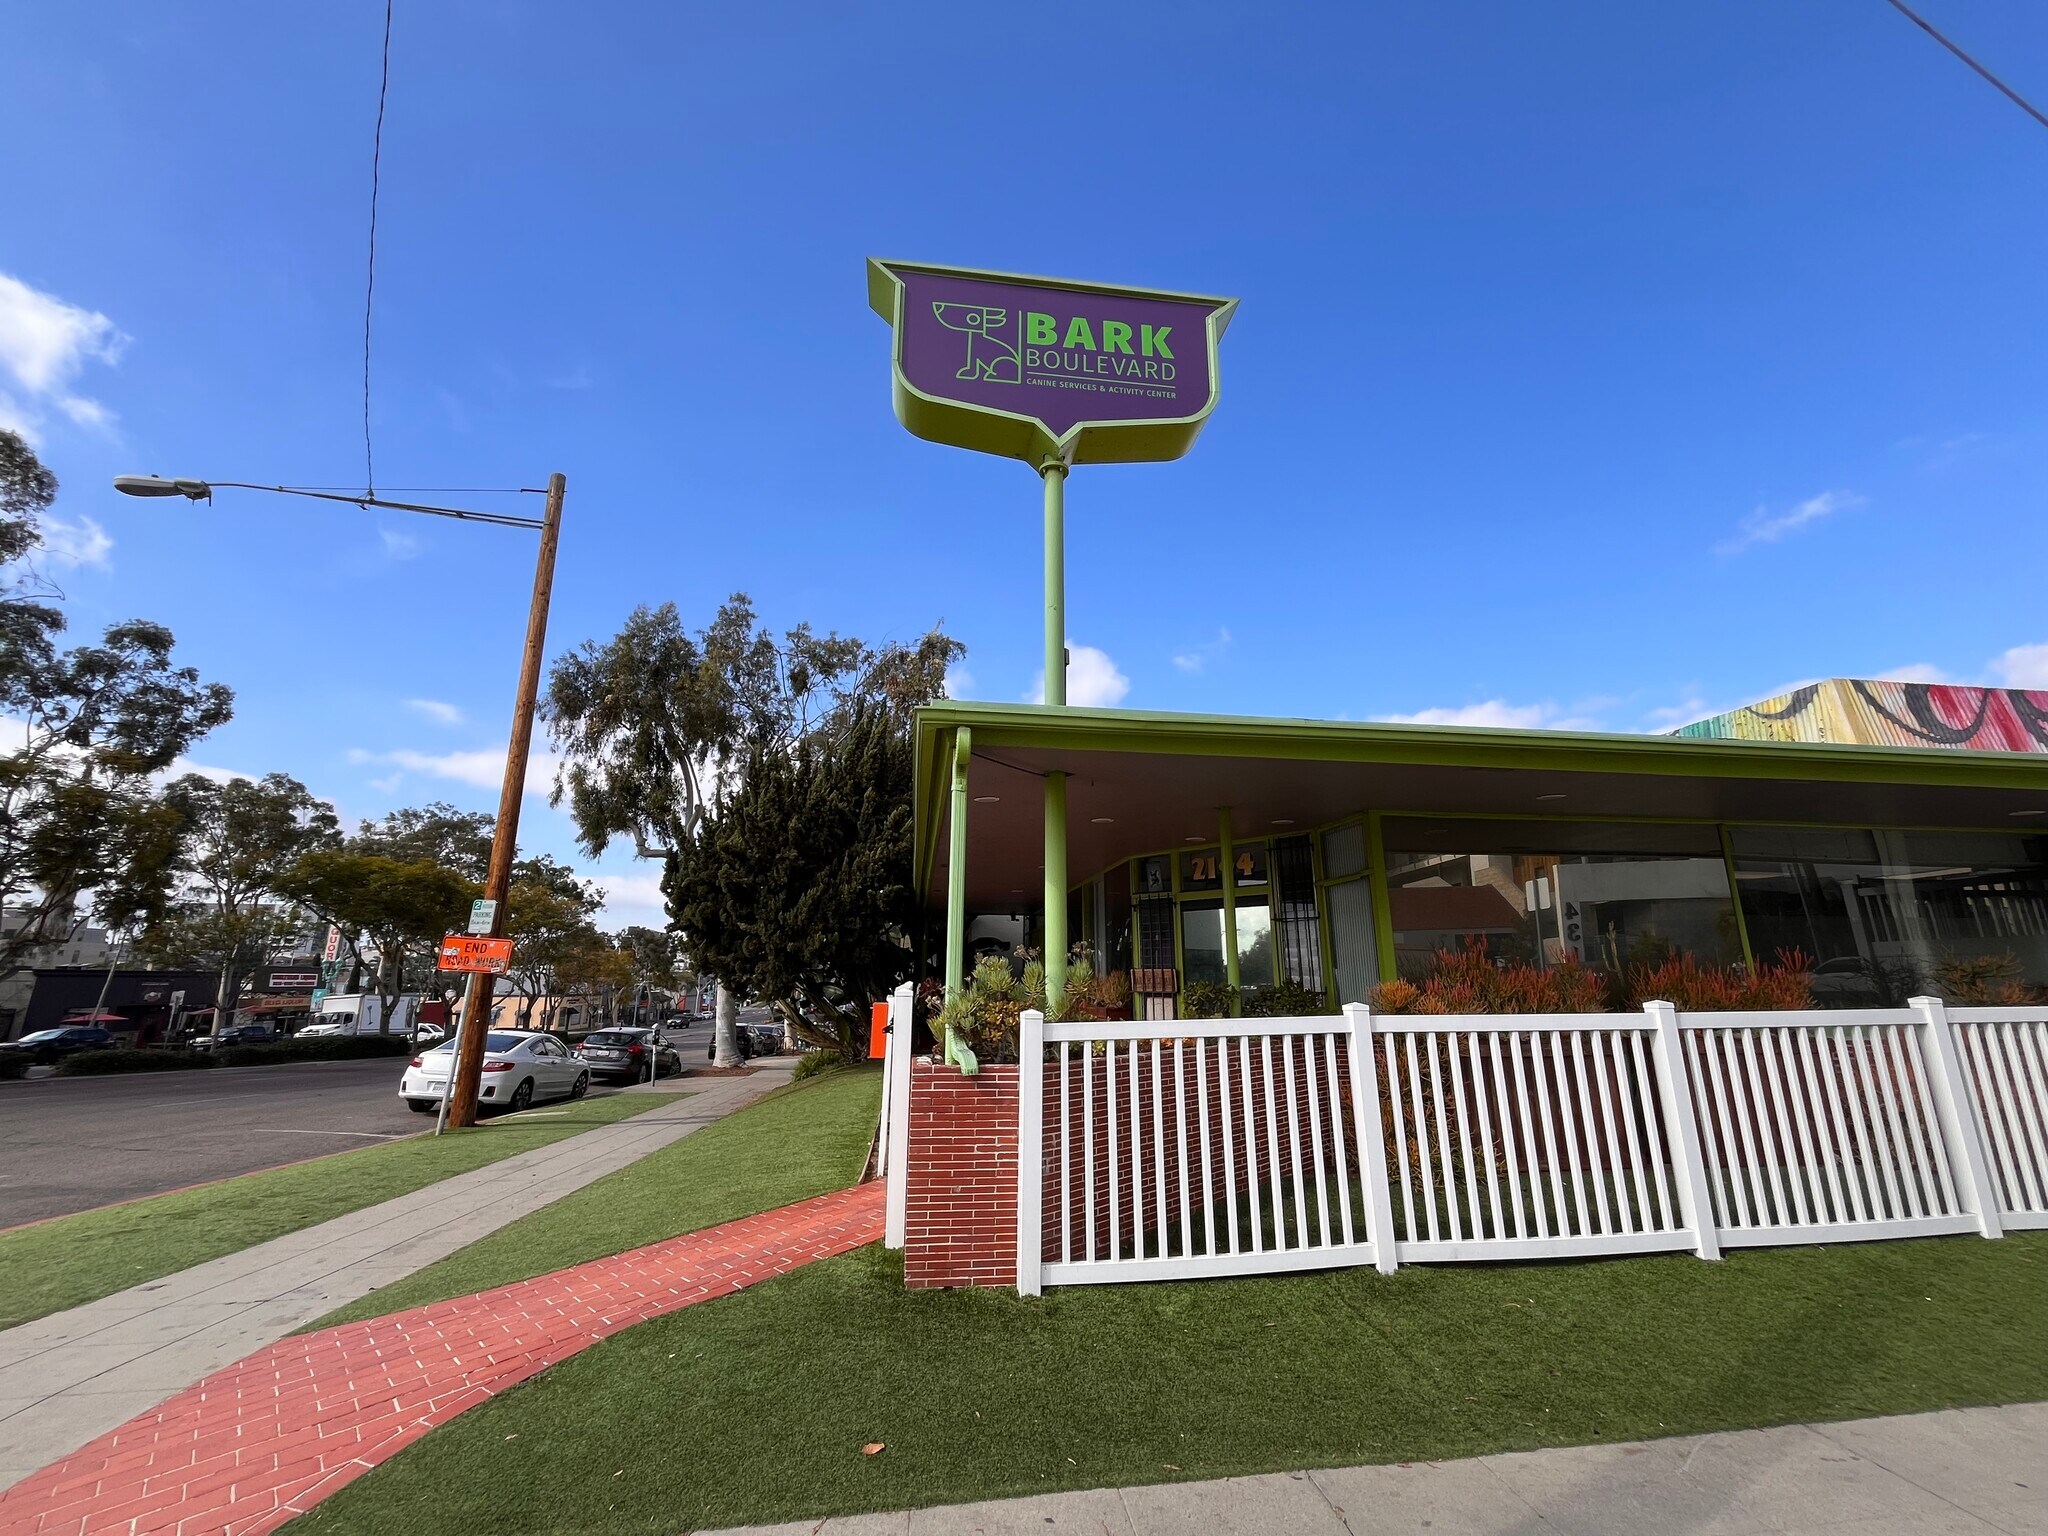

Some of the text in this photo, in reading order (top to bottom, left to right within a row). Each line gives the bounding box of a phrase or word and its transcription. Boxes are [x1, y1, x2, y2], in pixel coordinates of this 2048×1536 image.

[1026, 312, 1175, 359] BARK
[1026, 348, 1176, 381] BOULEVARD
[1026, 378, 1177, 400] CANINE SERVICES & ACTIVITY CENTER
[1191, 852, 1254, 881] 214
[474, 901, 481, 909] 2
[472, 911, 492, 919] PARKING
[464, 942, 488, 954] END
[445, 955, 470, 966] ROAD
